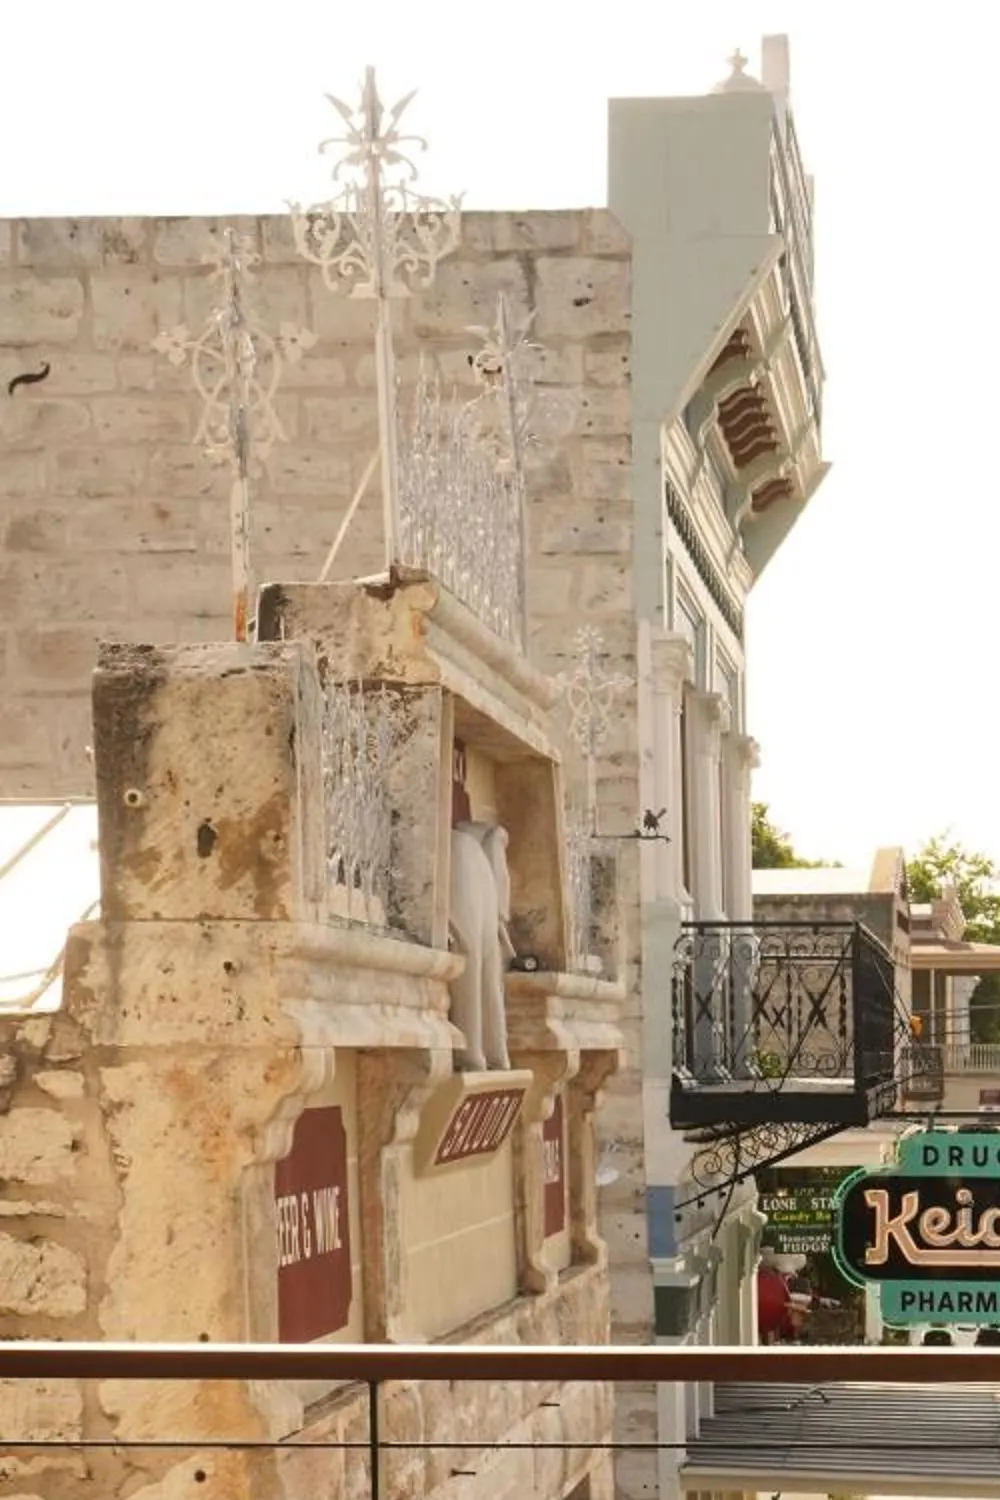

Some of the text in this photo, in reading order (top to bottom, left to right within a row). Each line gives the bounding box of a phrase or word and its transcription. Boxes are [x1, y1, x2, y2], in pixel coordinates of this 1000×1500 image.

[762, 1198, 797, 1211] LONE
[275, 1193, 301, 1268] EER
[313, 1185, 342, 1254] WINE
[782, 1242, 829, 1253] FUDGE
